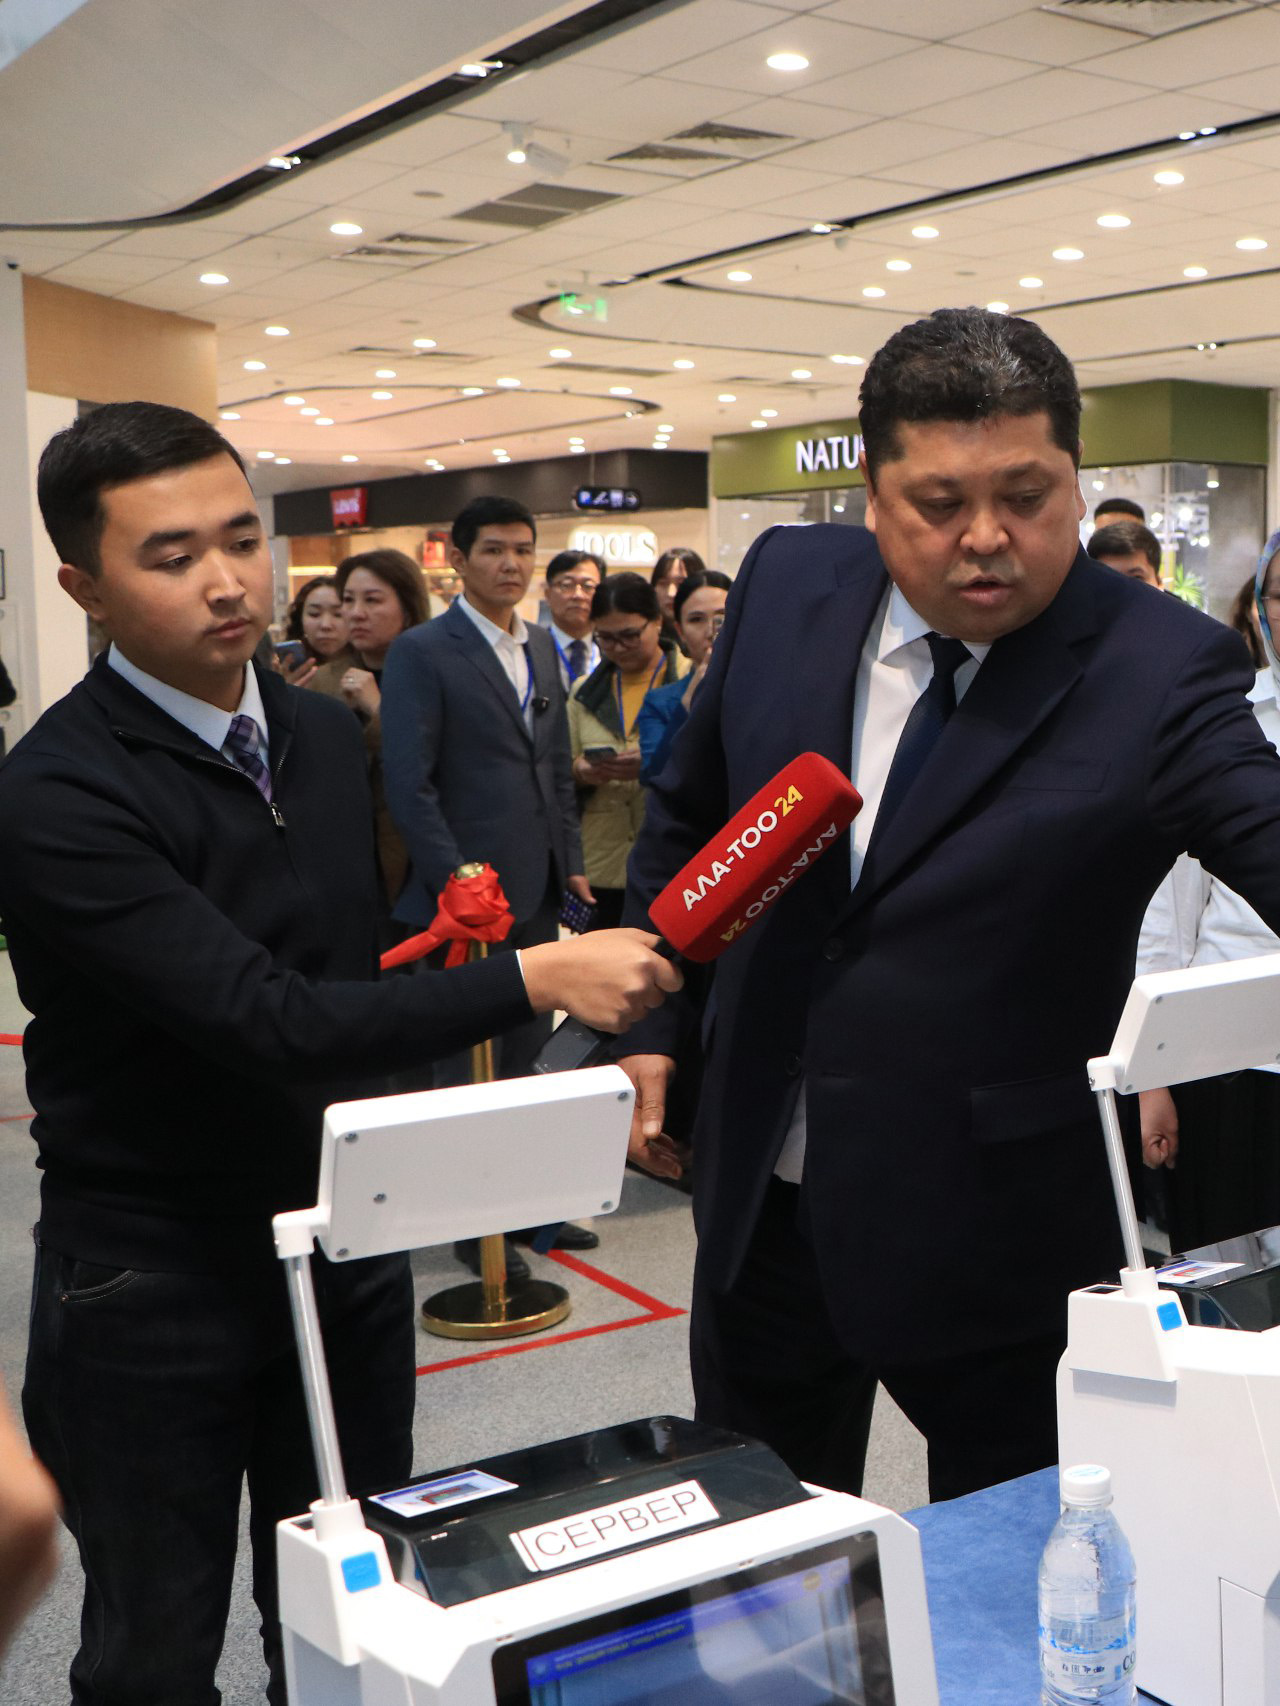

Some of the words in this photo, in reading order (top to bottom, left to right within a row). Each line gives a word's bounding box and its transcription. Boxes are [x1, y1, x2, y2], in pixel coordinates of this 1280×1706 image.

[682, 810, 778, 911] АЛА-ТОО
[774, 784, 804, 817] 24
[745, 822, 838, 919] АЛА-ТОО
[719, 918, 748, 942] 24
[534, 1490, 697, 1557] СЕРВЕР
